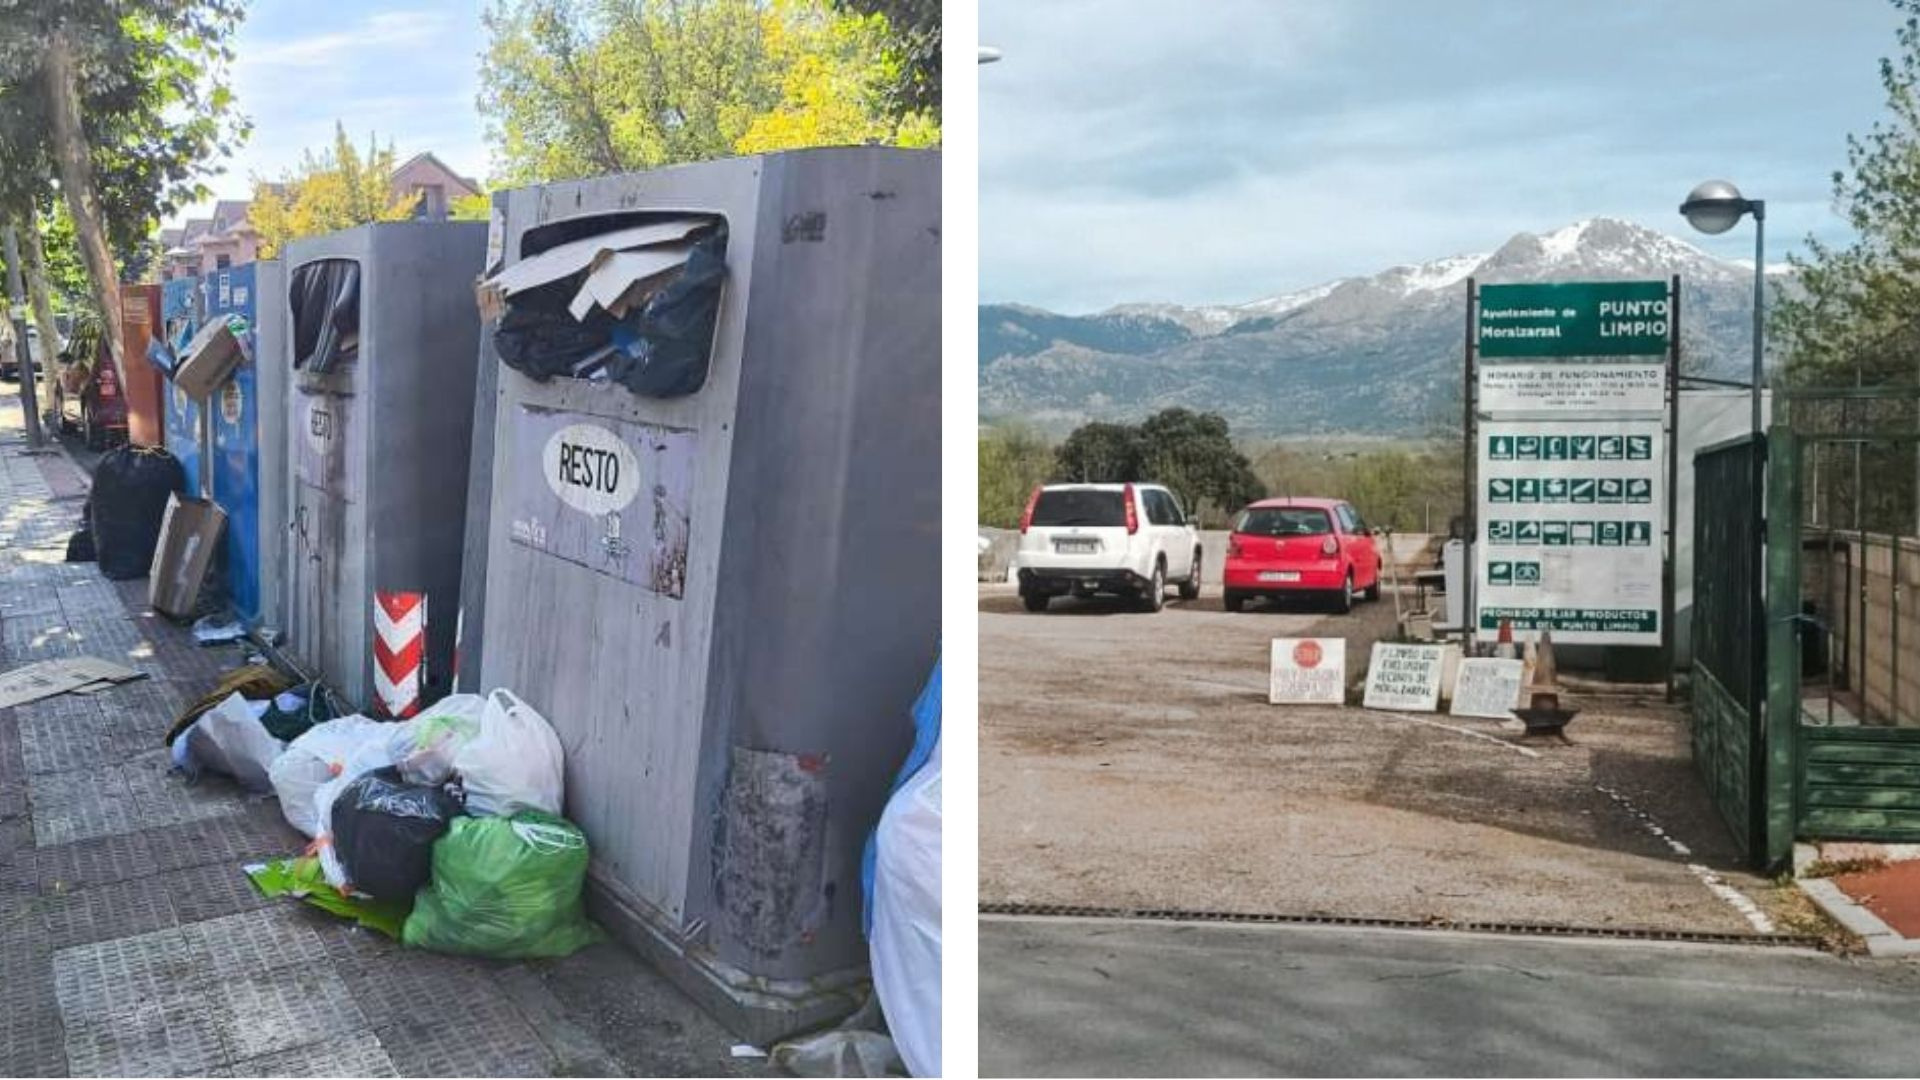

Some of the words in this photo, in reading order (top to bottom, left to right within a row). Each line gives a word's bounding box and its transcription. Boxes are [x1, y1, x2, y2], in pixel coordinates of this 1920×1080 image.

[1481, 308, 1556, 319] Ayuntamiento
[1562, 308, 1577, 318] de
[1600, 301, 1667, 316] PUNTO
[1481, 326, 1562, 338] Moralzarzal
[1600, 321, 1667, 337] LIMPIO
[559, 442, 619, 494] RESTO
[1582, 611, 1649, 620] PRODUCTOS
[1562, 621, 1598, 630] PUNTO
[1603, 622, 1640, 630] LIMPIO
